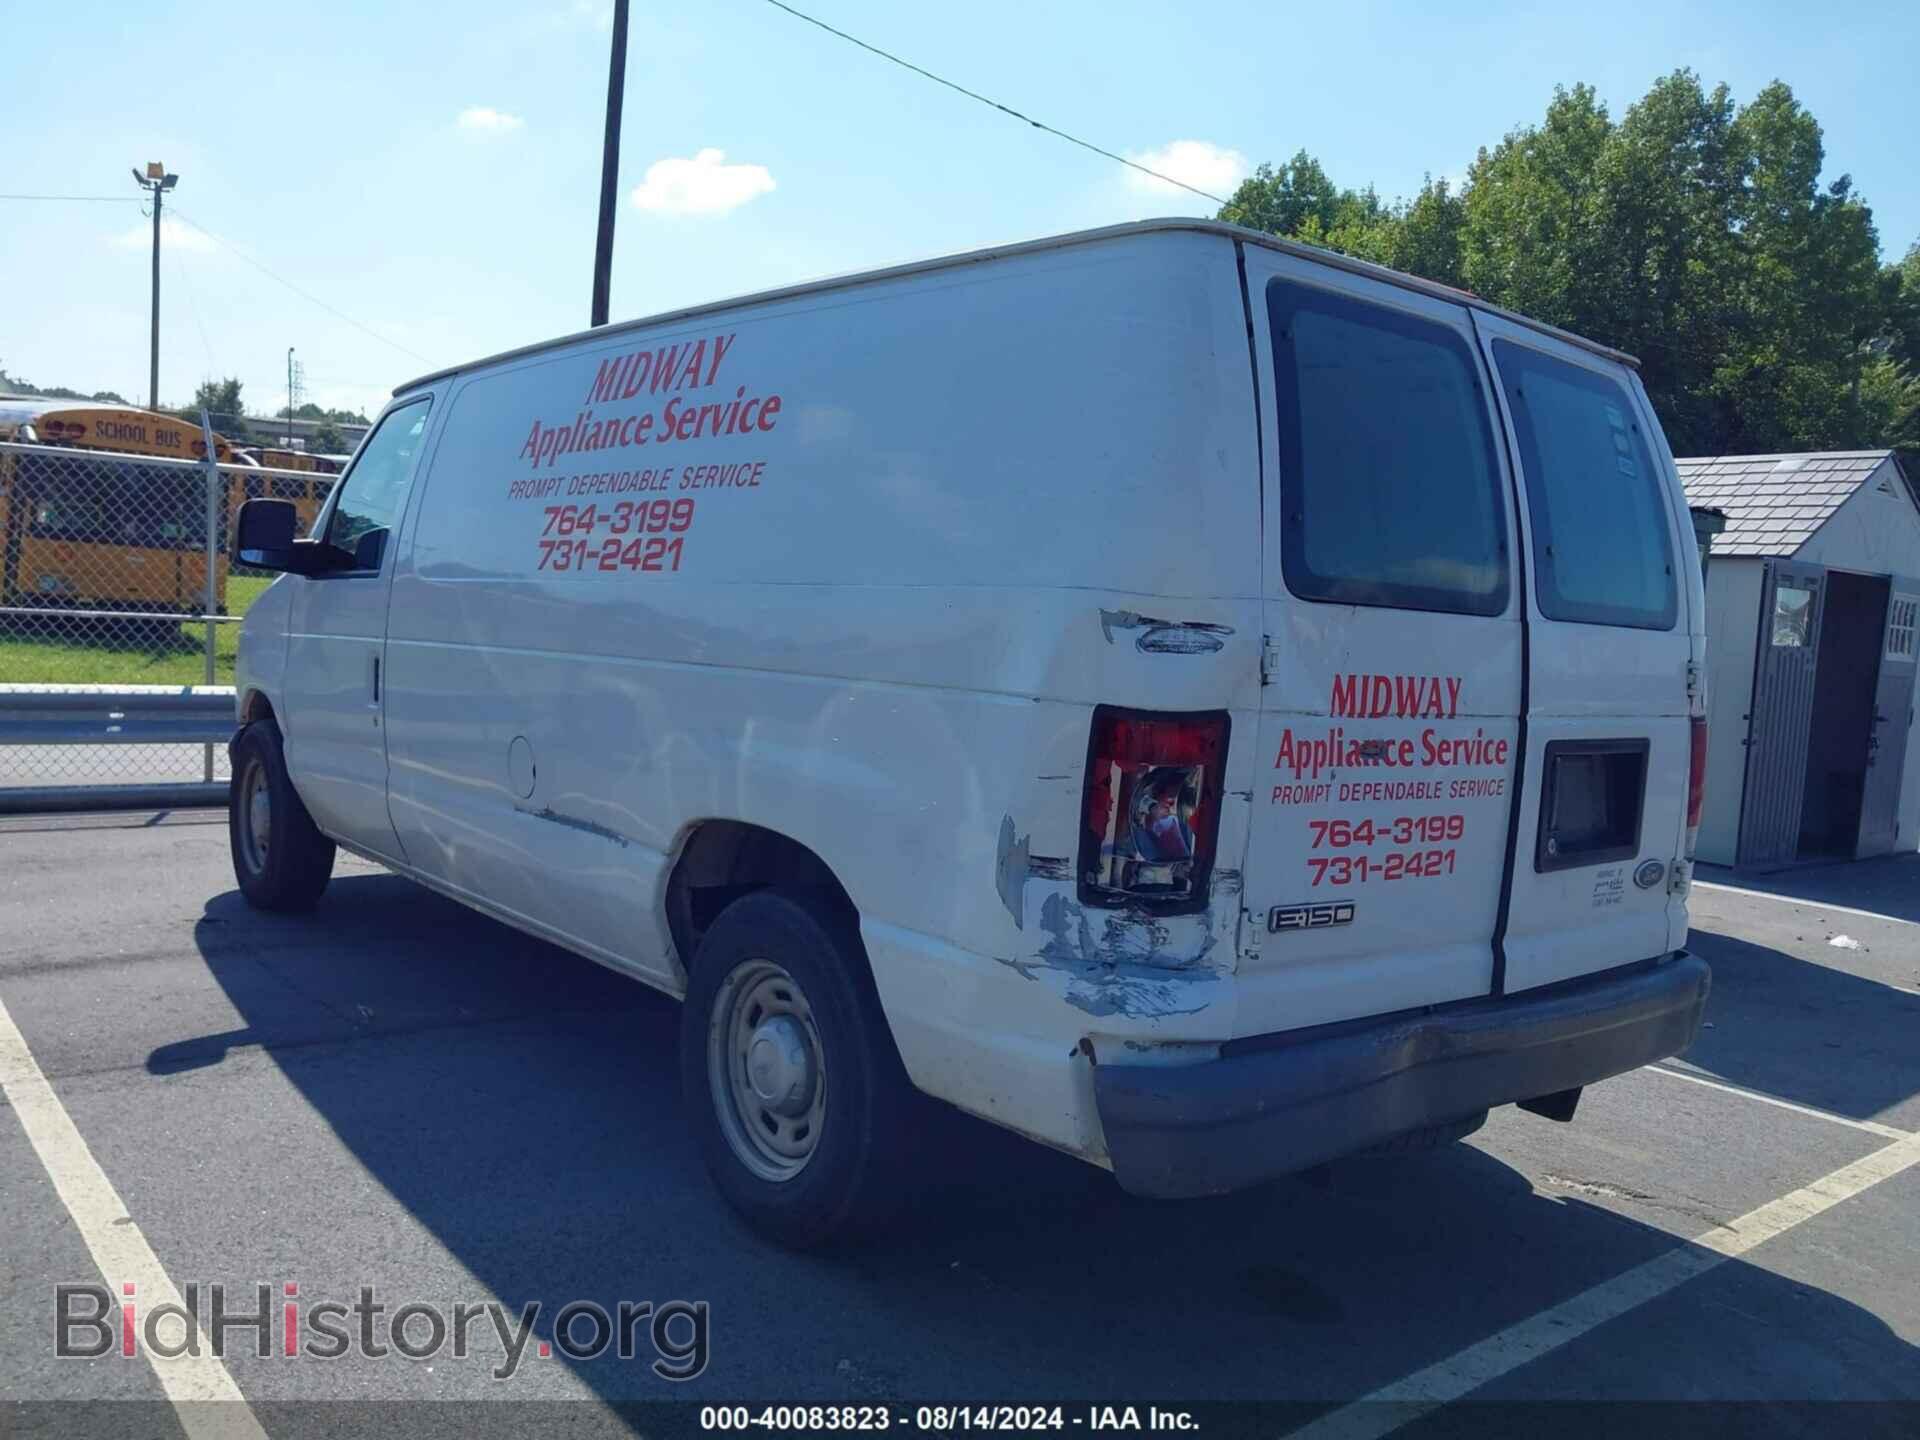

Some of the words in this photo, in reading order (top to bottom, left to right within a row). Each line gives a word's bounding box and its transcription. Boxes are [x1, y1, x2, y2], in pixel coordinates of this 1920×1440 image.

[586, 334, 736, 405] MIDWAY
[96, 420, 148, 444] SCHOOL
[155, 429, 182, 449] BUS
[520, 410, 653, 469] Appliance
[656, 385, 783, 443] Service
[508, 478, 564, 499] PROMPT
[567, 468, 674, 496] DEPENDABLE
[679, 463, 766, 489] SERVICE
[542, 498, 695, 536] 764-3199
[537, 537, 684, 572] 731-2421
[1330, 674, 1463, 720] MIDWAY
[1420, 728, 1509, 768] Service
[1271, 783, 1331, 805] PROMPT
[1338, 781, 1443, 802] DEPENDABLE
[1449, 778, 1506, 799] SERVICE
[1309, 815, 1465, 849] 764-3199
[1307, 849, 1456, 886] 731-2421
